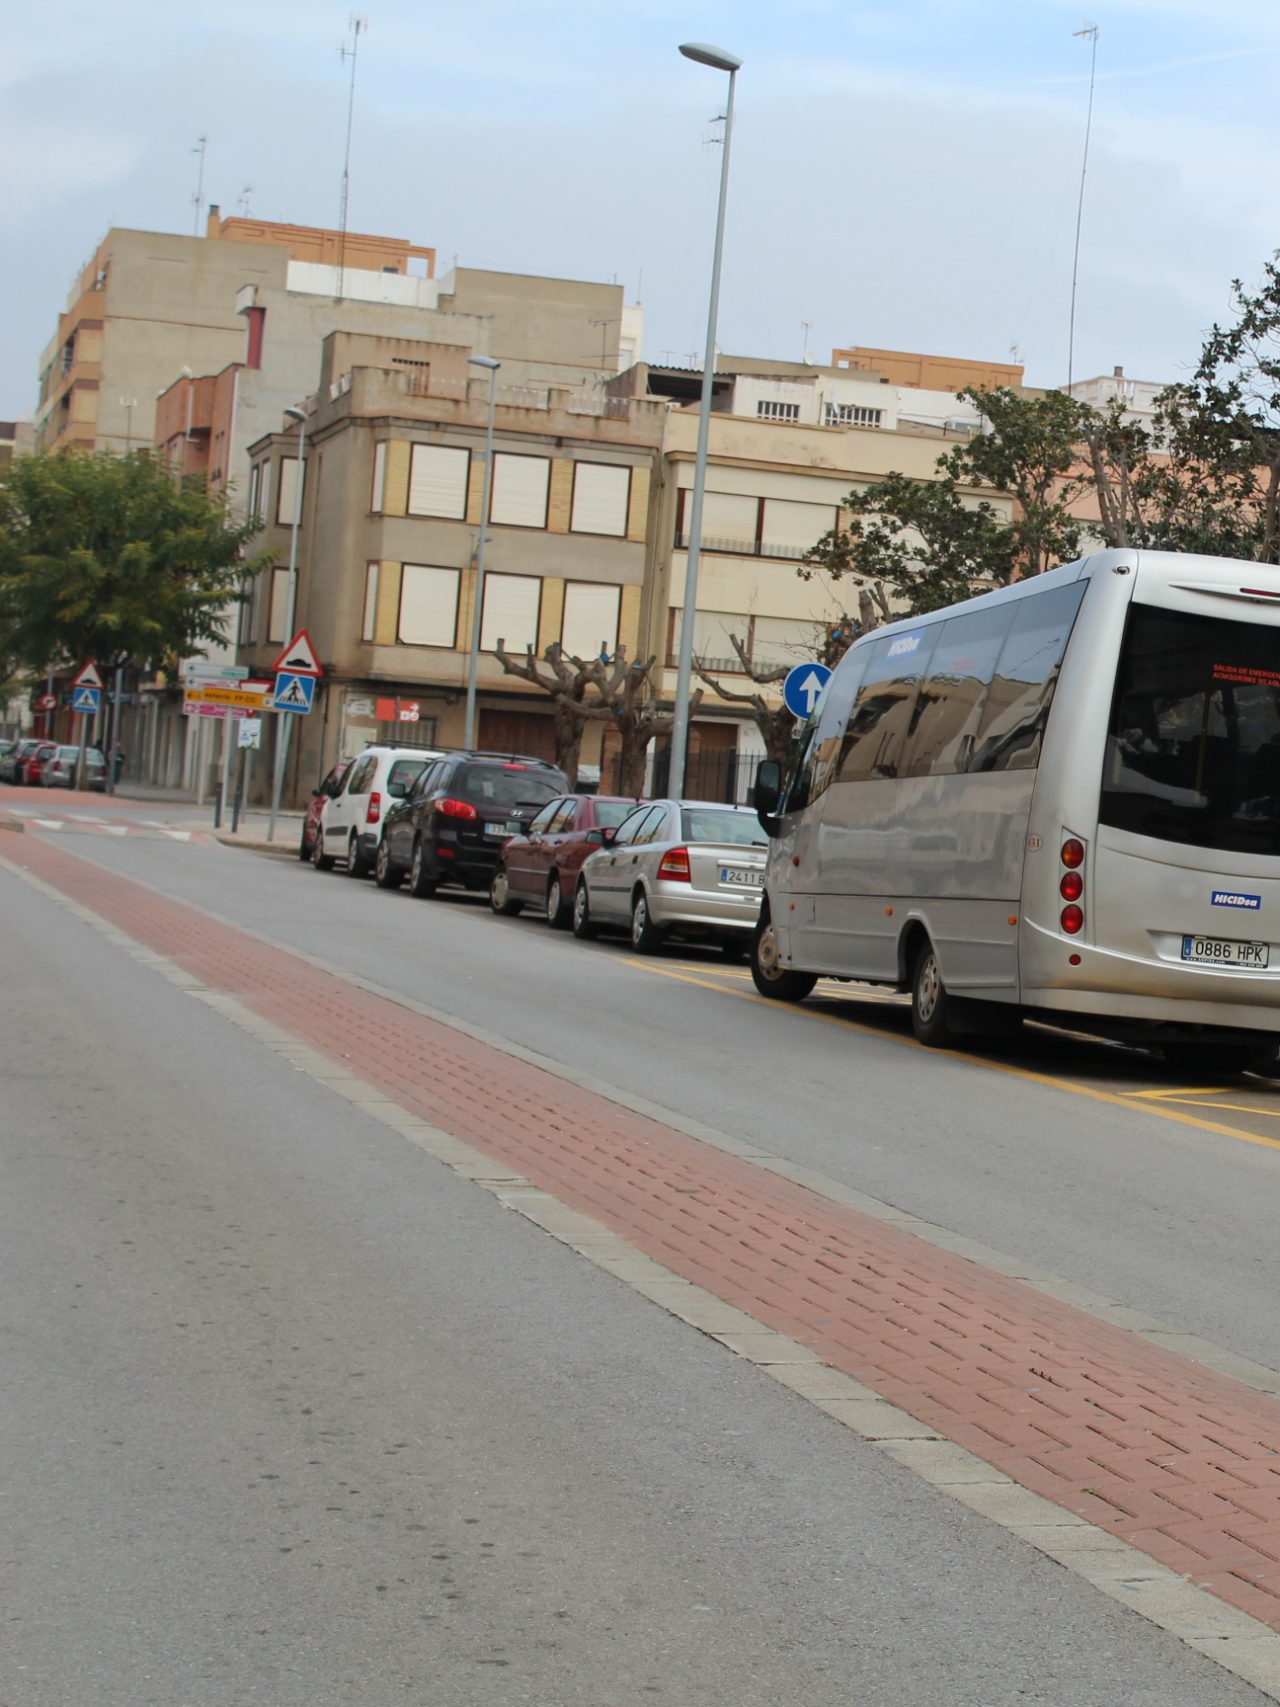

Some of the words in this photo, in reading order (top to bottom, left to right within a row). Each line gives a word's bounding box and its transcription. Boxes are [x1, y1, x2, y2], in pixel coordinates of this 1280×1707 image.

[1213, 664, 1237, 673] SALIDA
[729, 871, 755, 883] 2411
[1195, 941, 1232, 959] 0886
[1237, 945, 1264, 962] HPK
